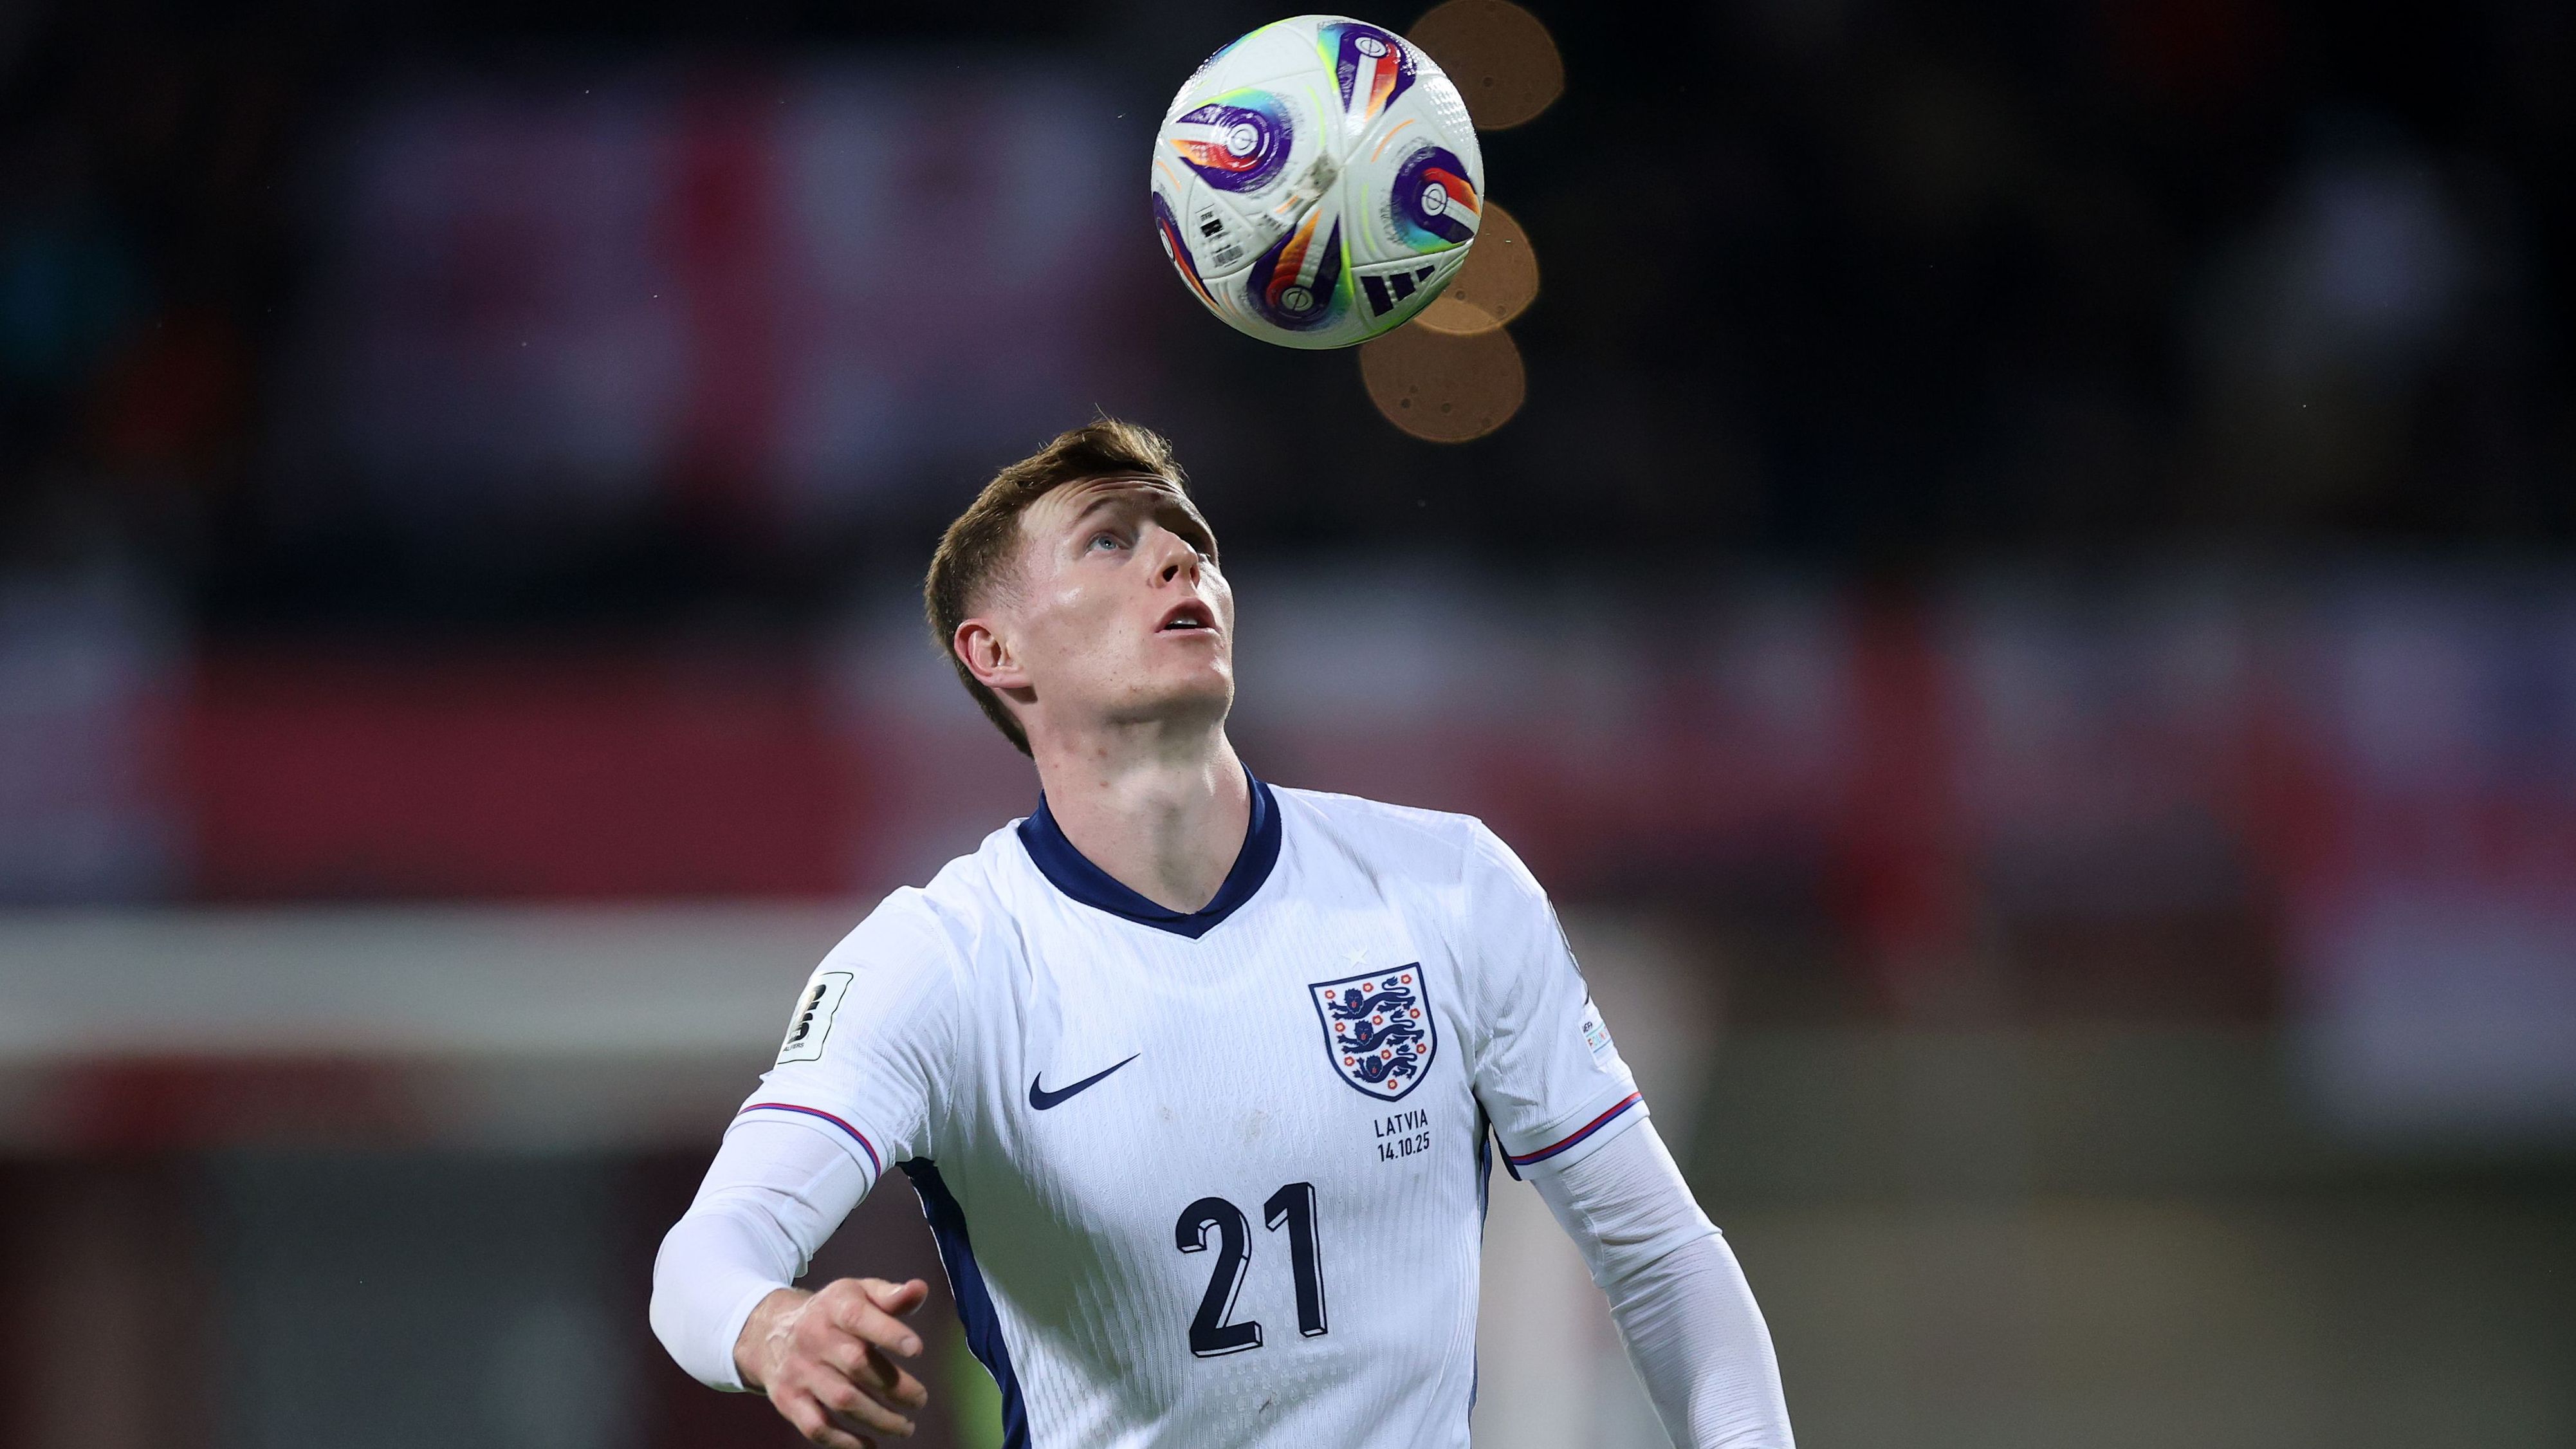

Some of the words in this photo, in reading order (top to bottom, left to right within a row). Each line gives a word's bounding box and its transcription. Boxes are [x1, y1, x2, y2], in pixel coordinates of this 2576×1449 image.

[1374, 1109, 1428, 1138] LATVIA
[1377, 1131, 1430, 1162] 14.10.25
[1175, 1181, 1328, 1358] 21
